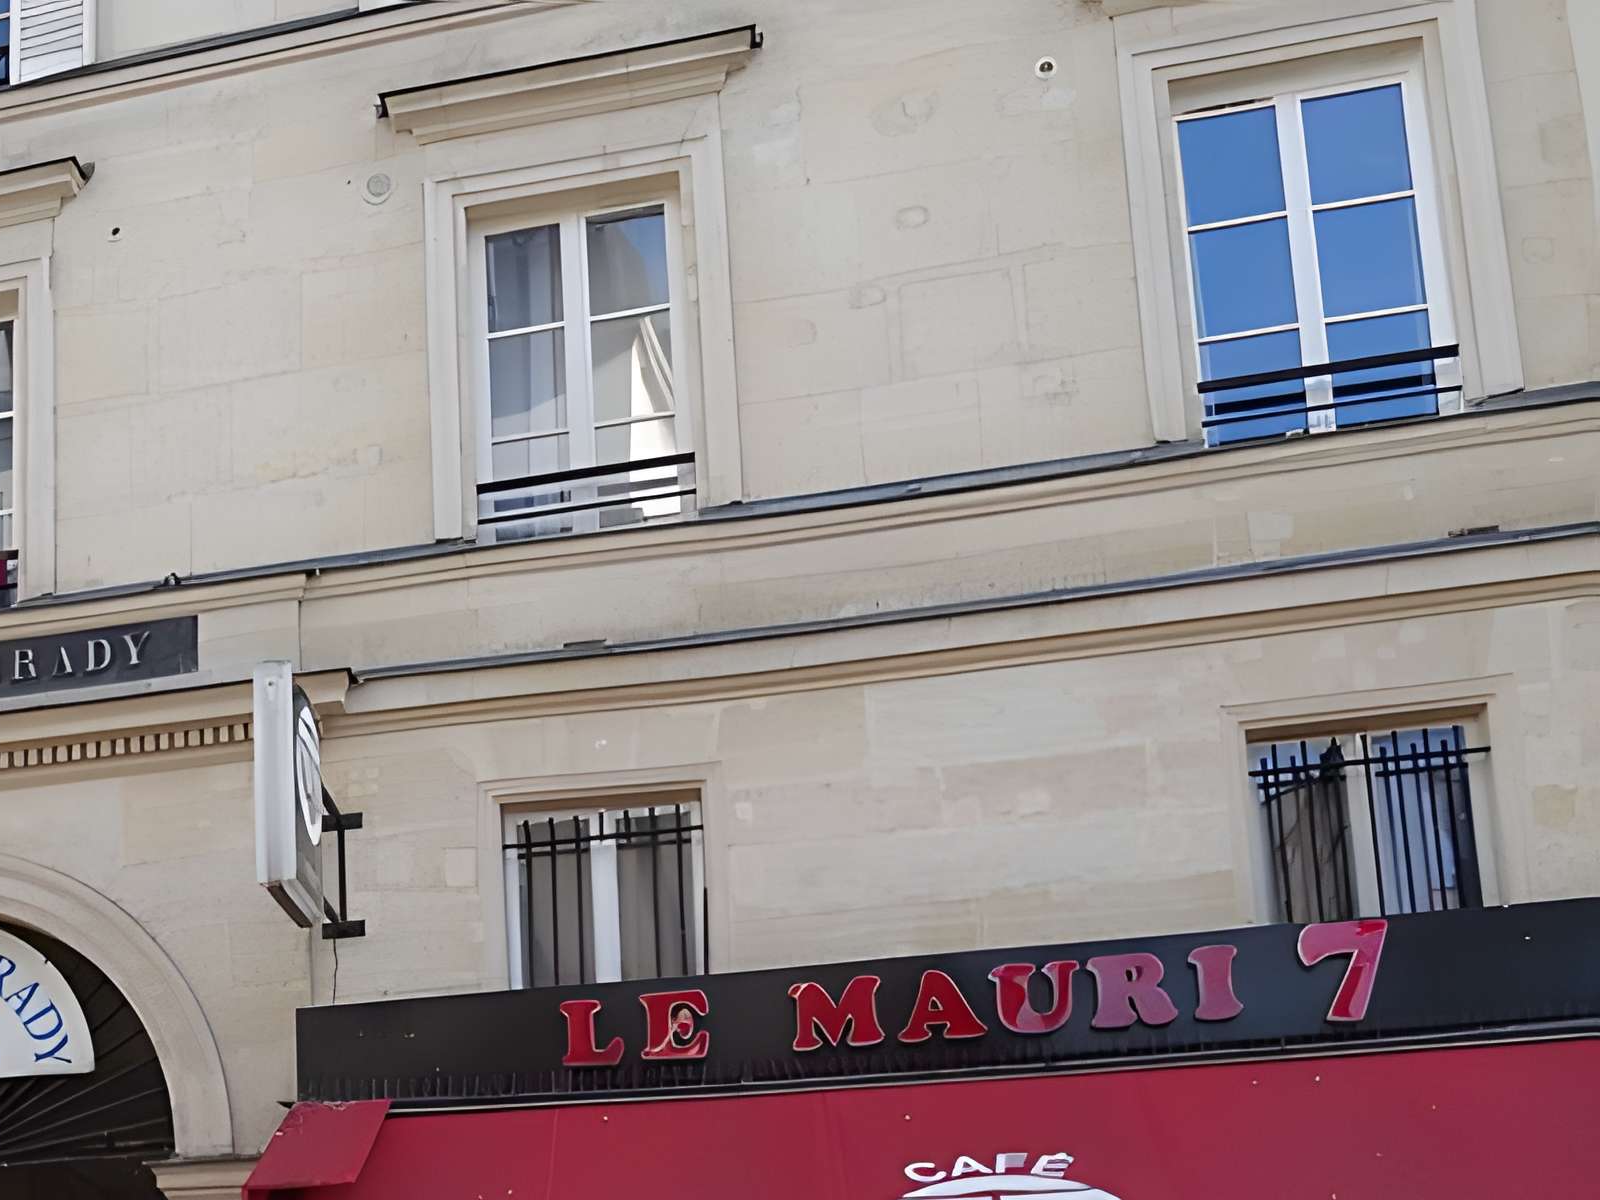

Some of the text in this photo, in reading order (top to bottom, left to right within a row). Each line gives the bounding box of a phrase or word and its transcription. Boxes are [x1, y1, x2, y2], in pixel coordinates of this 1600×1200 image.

[559, 918, 1389, 1066] LE MAURI 7
